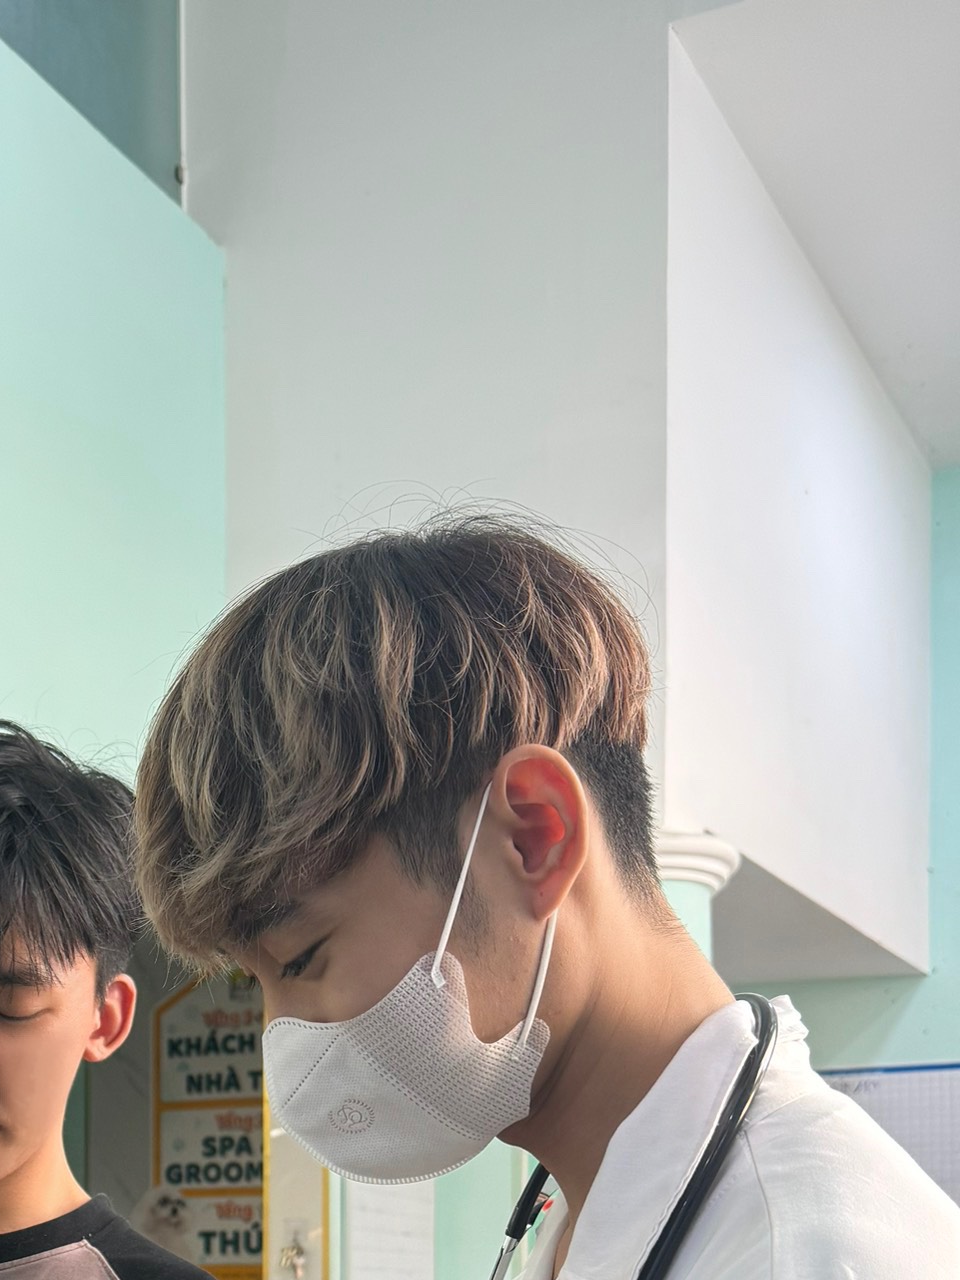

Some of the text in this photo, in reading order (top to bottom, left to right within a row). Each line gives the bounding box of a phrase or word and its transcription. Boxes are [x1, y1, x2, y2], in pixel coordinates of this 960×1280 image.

[167, 1028, 255, 1058] KHÁCH
[186, 1065, 241, 1095] NHÀ
[202, 1135, 253, 1158] SPA
